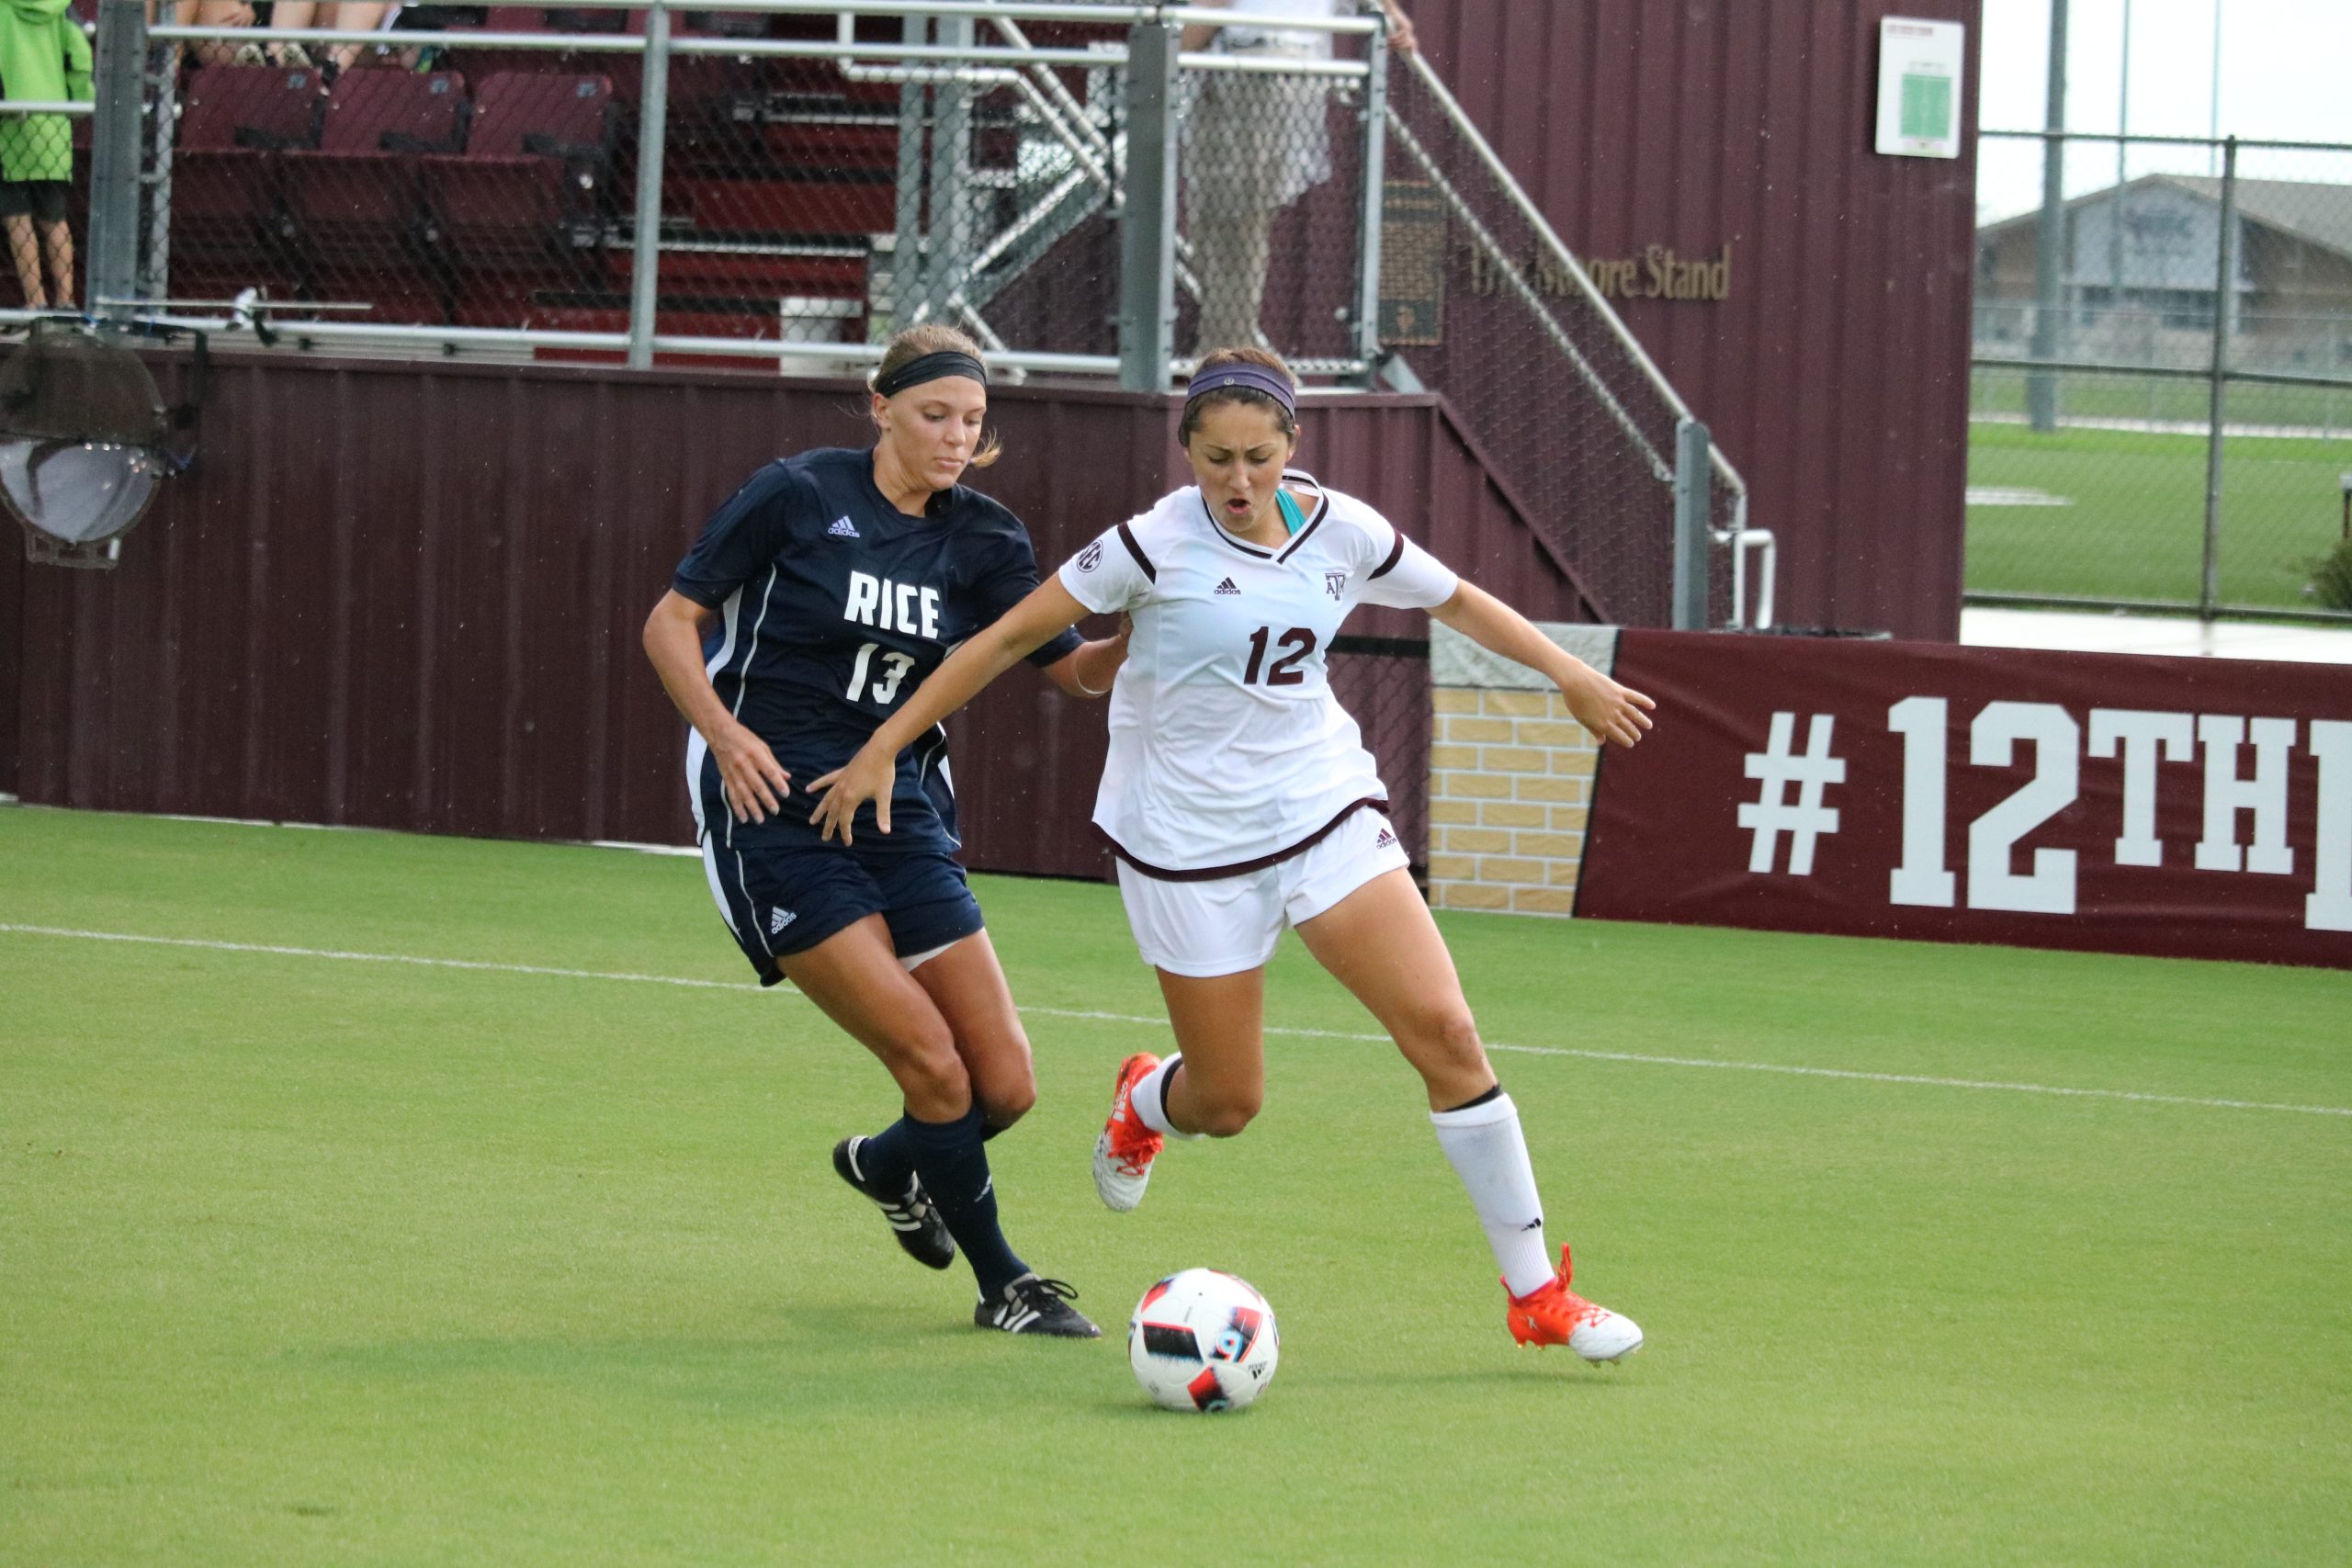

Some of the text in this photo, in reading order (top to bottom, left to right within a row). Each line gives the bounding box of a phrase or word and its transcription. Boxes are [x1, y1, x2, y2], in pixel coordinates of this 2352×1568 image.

[1645, 243, 1732, 299] Stand
[828, 527, 861, 538] adidas
[843, 570, 939, 639] RICE
[846, 643, 915, 705] 13
[1243, 626, 1317, 686] 12
[772, 912, 797, 934] adidas
